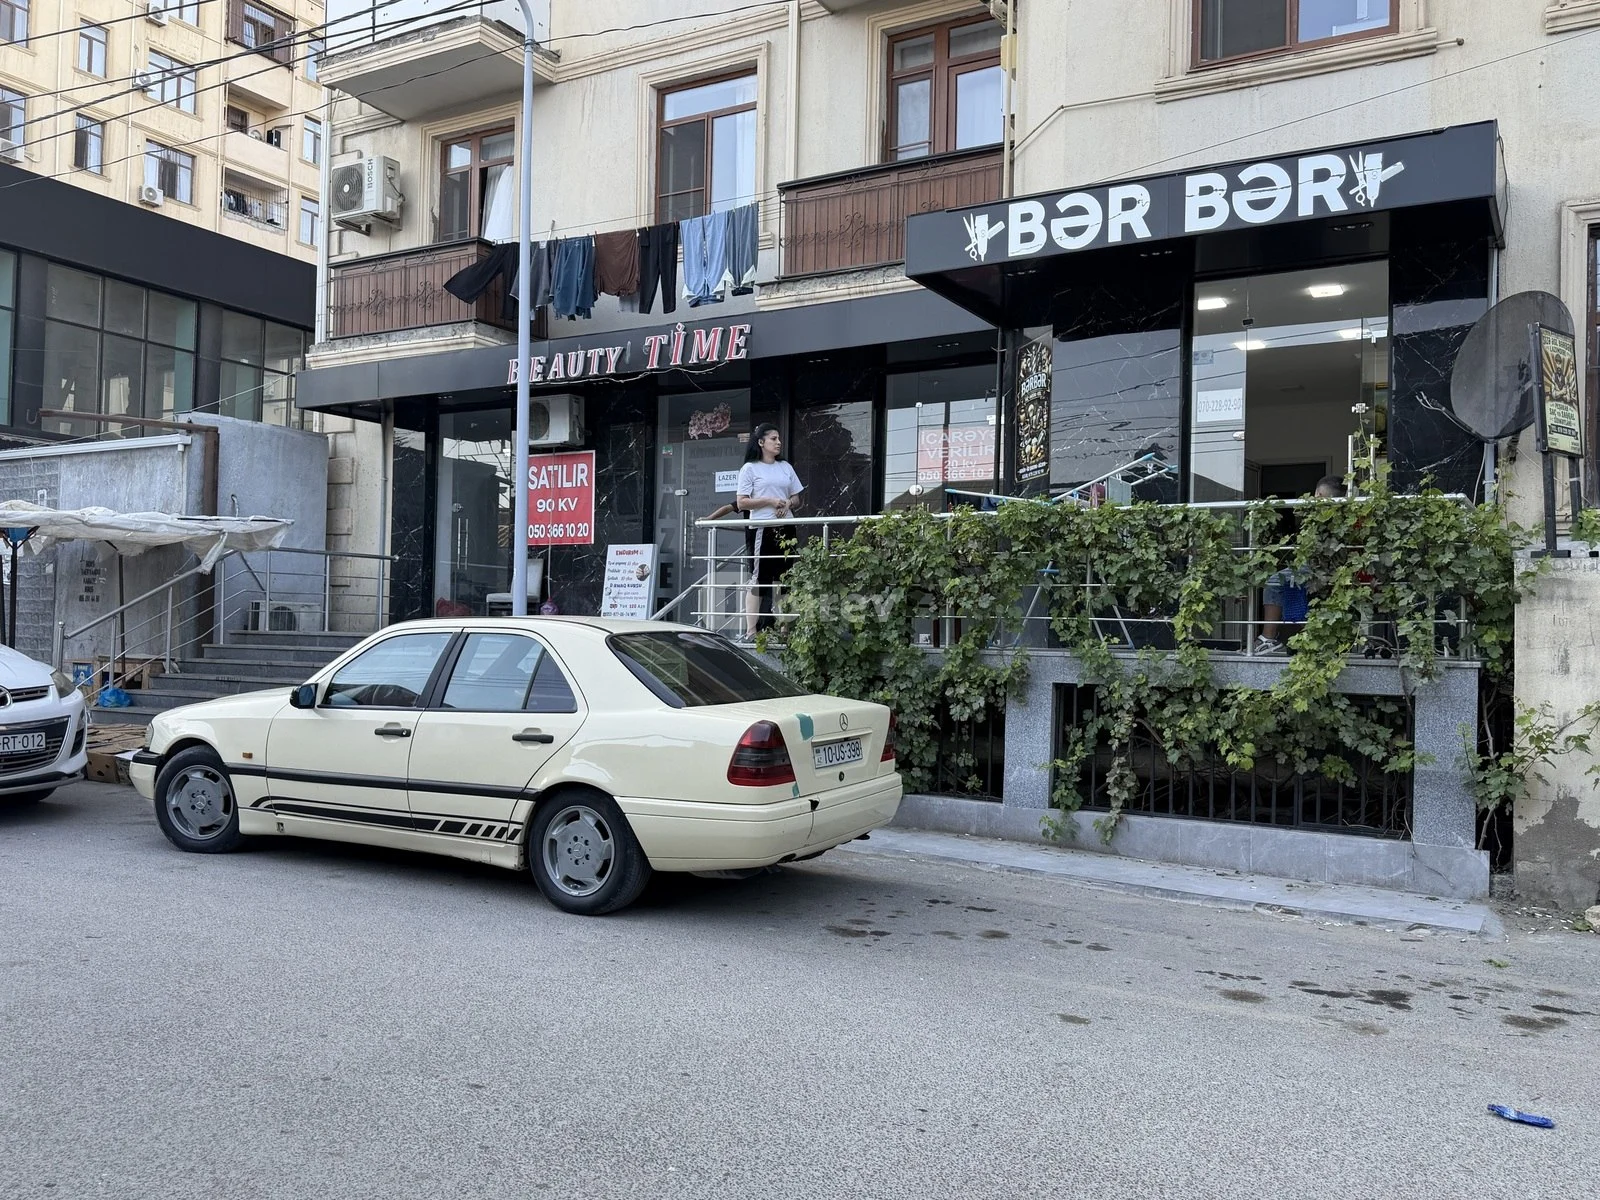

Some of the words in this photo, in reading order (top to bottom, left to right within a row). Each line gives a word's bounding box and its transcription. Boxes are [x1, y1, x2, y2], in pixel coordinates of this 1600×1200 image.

[1007, 183, 1152, 257] BƏR
[1184, 153, 1349, 233] BƏR
[507, 346, 624, 384] BEAUTY
[528, 463, 589, 490] SATILIR
[919, 470, 940, 480] 050
[944, 469, 966, 479] 366
[972, 468, 984, 478] 10
[536, 498, 555, 513] 90
[558, 497, 579, 512] KV
[528, 524, 546, 539] 050
[547, 523, 564, 538] 366
[565, 523, 576, 537] 10
[577, 522, 589, 537] 20
[823, 741, 860, 764] 10-US-398
